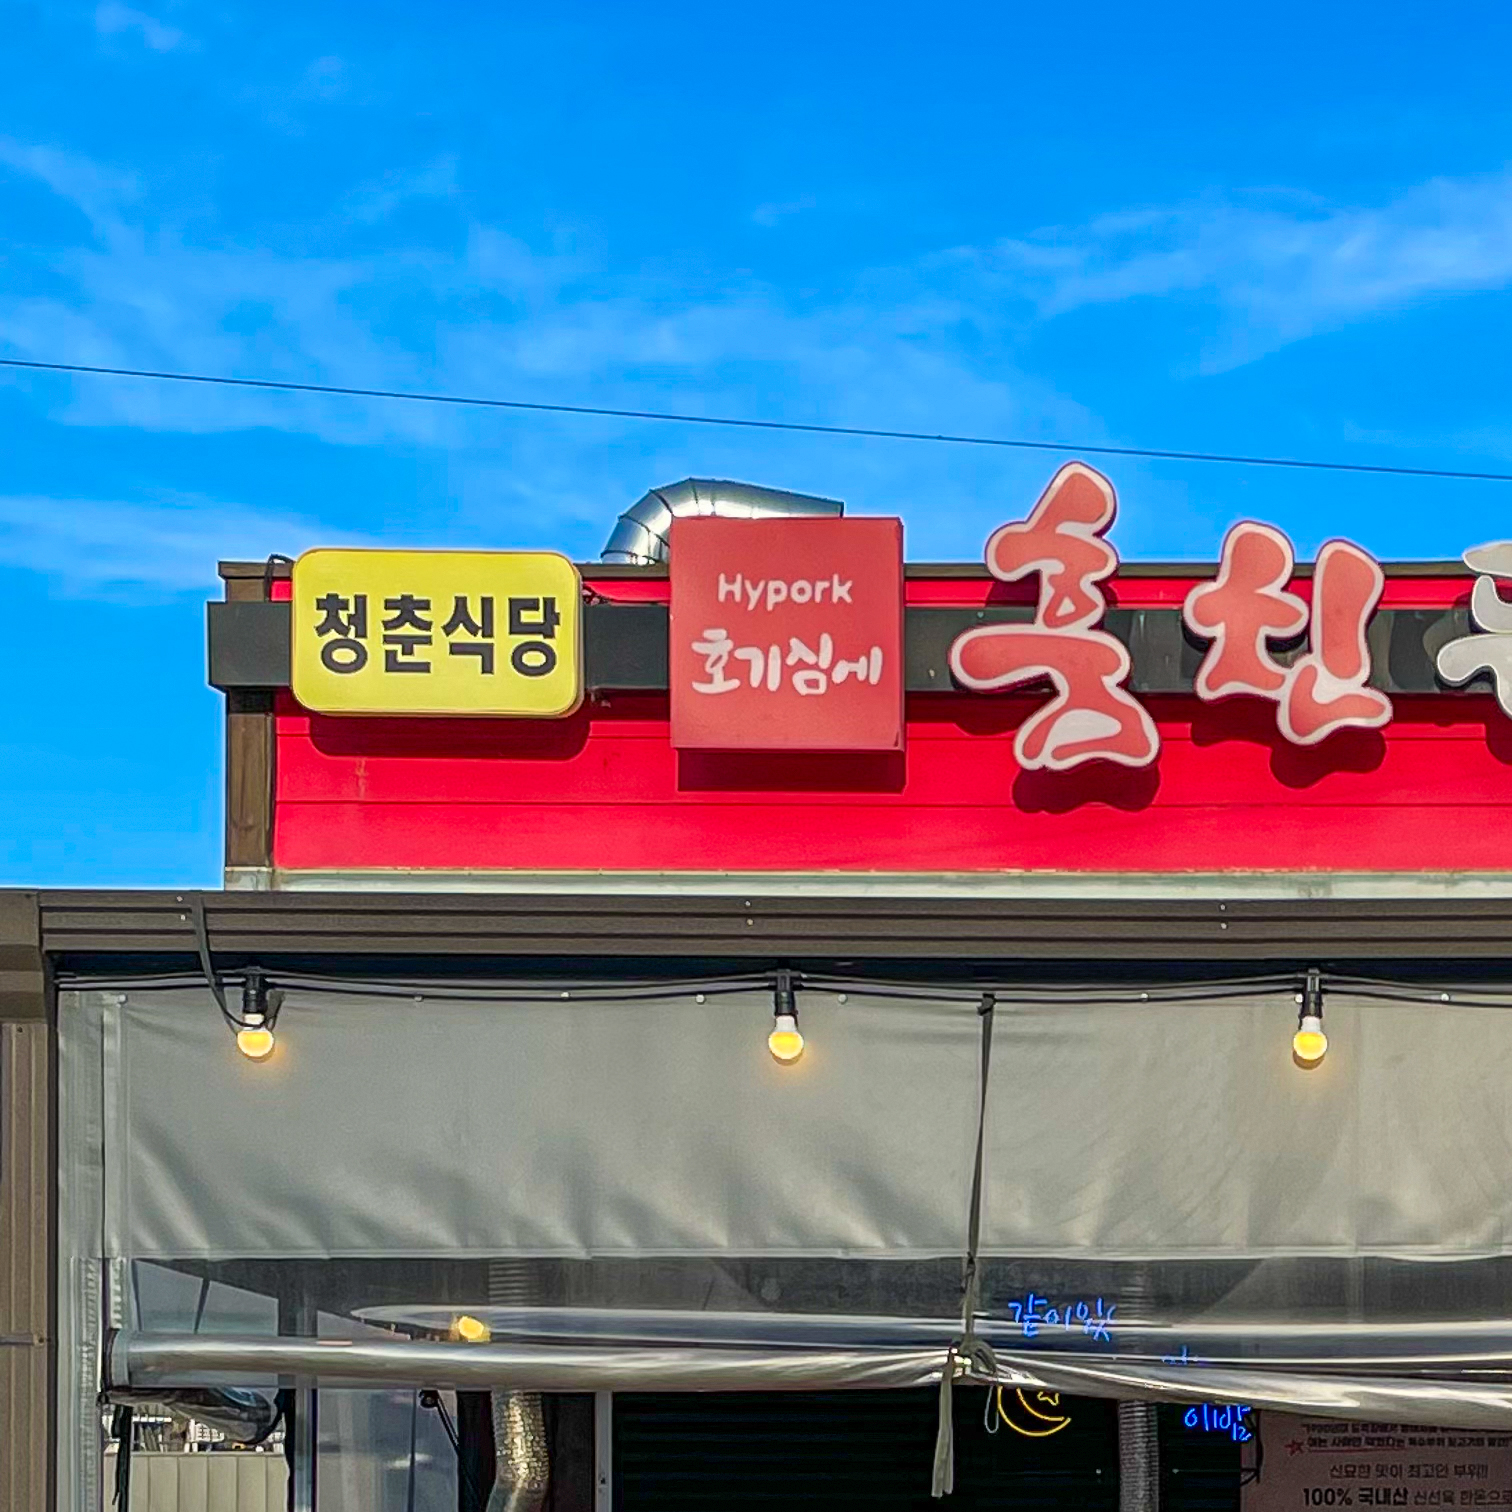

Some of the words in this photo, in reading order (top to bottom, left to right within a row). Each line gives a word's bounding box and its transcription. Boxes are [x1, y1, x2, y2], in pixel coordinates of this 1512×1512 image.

[718, 572, 854, 611] Hypork
[314, 592, 560, 676] 청춘식당
[691, 627, 884, 696] 호기심에
[1303, 1488, 1352, 1506] 100%
[1358, 1487, 1408, 1506] 국내산
